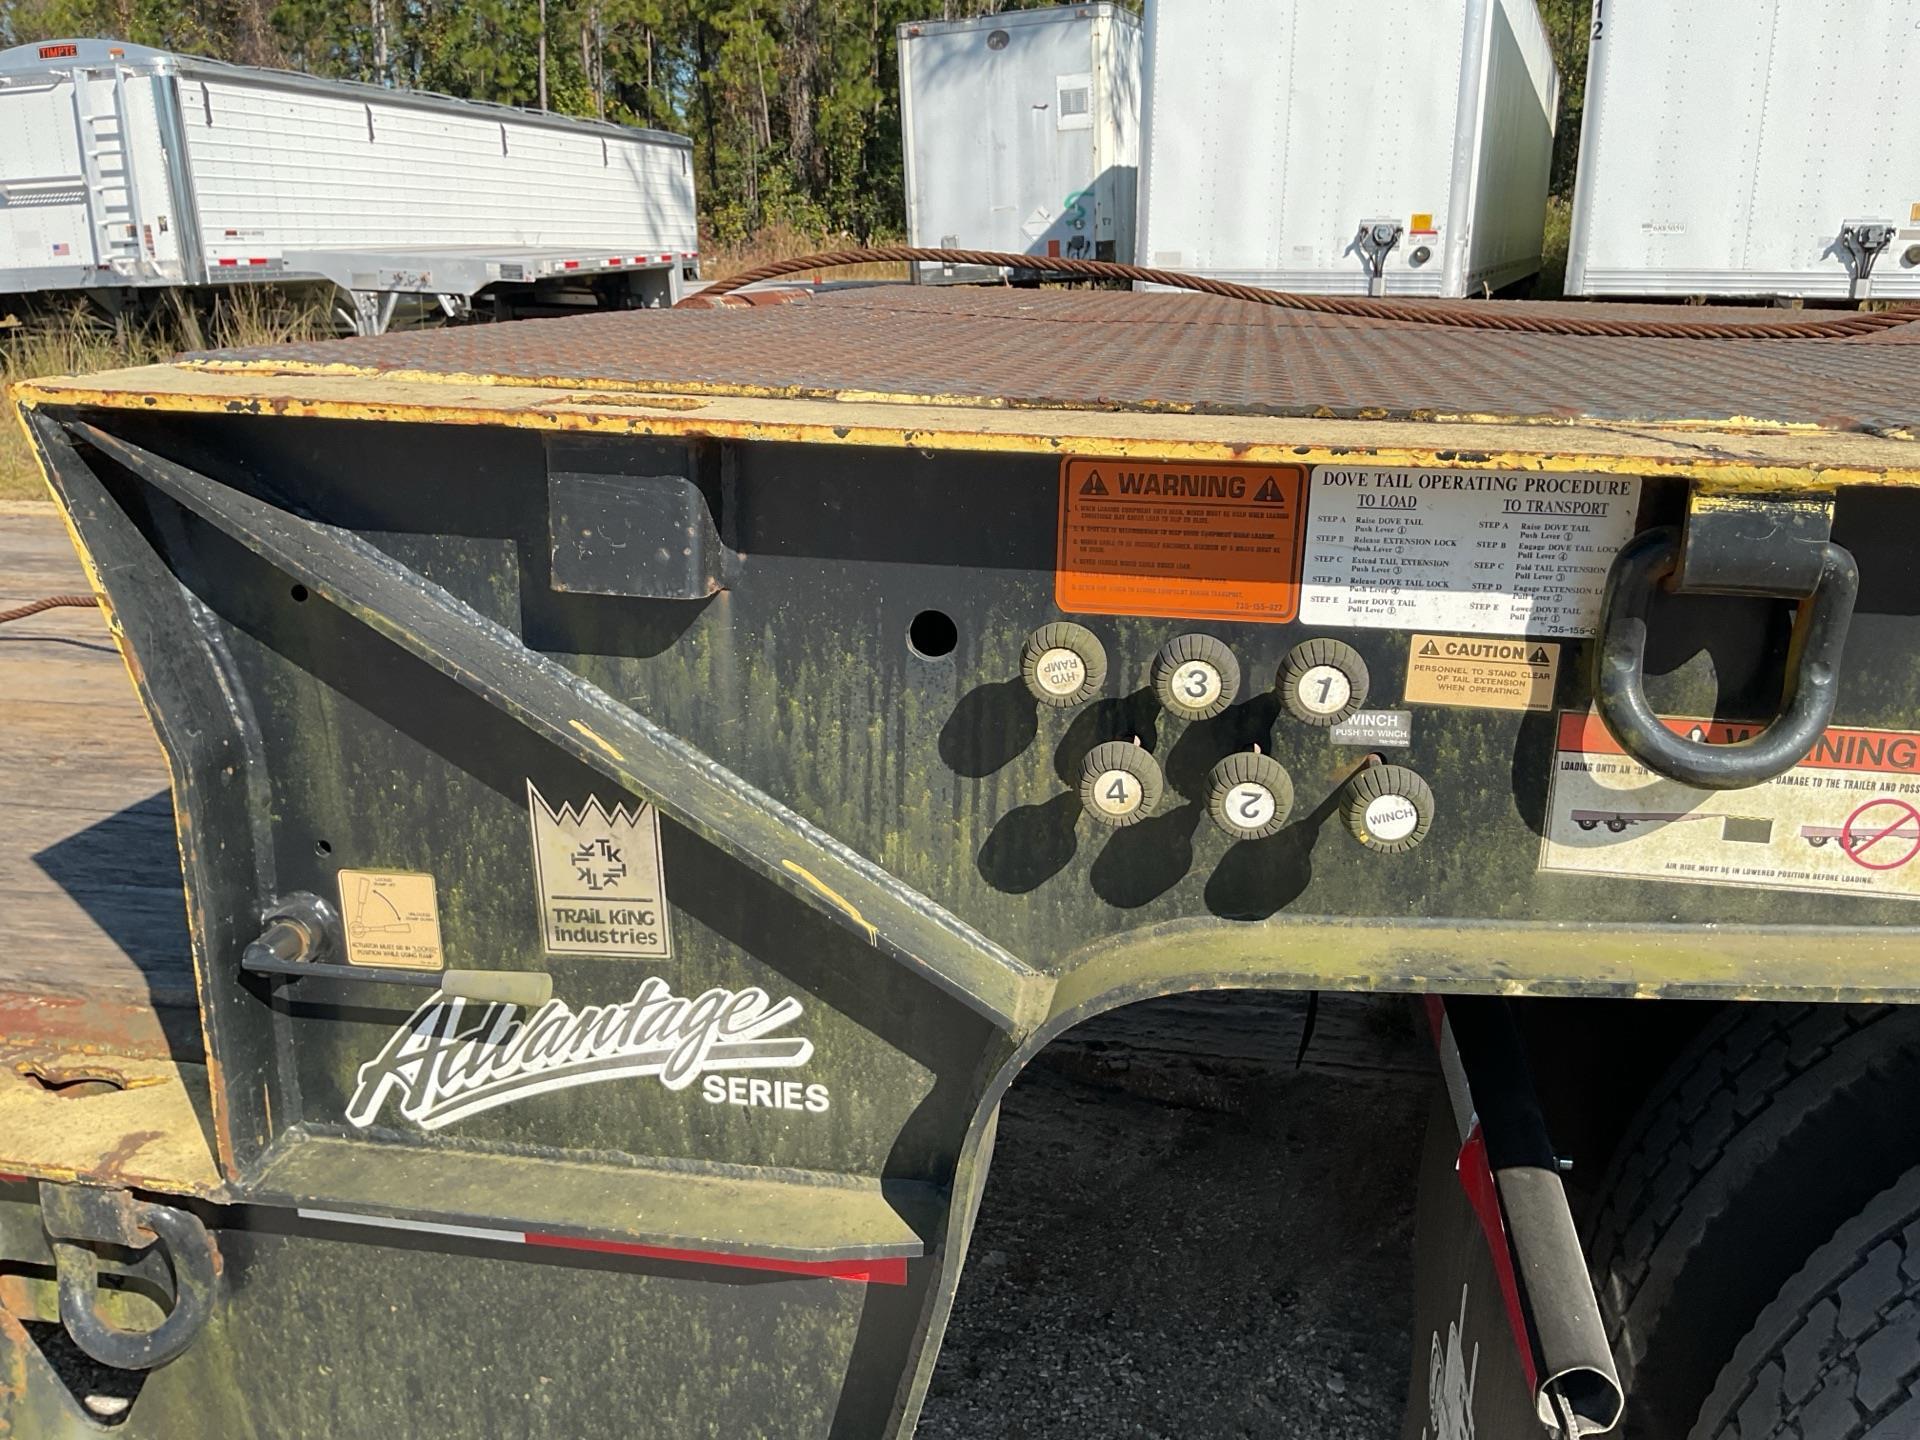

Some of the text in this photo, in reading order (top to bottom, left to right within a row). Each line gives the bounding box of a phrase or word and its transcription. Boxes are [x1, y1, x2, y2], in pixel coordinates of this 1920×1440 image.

[41, 45, 76, 58] TIMPTE
[1119, 473, 1246, 498] WARNING
[1323, 472, 1631, 495] DOVE TAIL OPERATING PROCEDURE
[1358, 494, 1417, 508] TO LOAD
[1504, 499, 1609, 515] TO TRANSPORT
[1519, 543, 1545, 551] Engage
[1401, 559, 1449, 567] EXTENSION
[1543, 586, 1591, 594] EXTENSION
[1446, 643, 1524, 659] CAUTION
[1044, 658, 1077, 673] RAMP
[1414, 665, 1467, 674] PERSONNEL
[1488, 670, 1516, 678] STAND
[1521, 671, 1550, 680] CLEAR
[1051, 672, 1076, 685] HYD
[1185, 669, 1208, 698] 3
[1437, 674, 1449, 682] OF
[1474, 678, 1526, 687] EXTENSION
[1317, 677, 1333, 704] 1
[1469, 686, 1522, 695] OPERATING.
[1348, 714, 1398, 726] WINCH
[1377, 730, 1407, 738] WINCH
[1561, 761, 1592, 772] LOADING
[1596, 763, 1616, 773] ONTO
[1619, 765, 1630, 774] AN
[1106, 778, 1128, 803] 4
[1776, 776, 1808, 787] DAMAGE
[1812, 777, 1822, 787] TO
[1826, 778, 1840, 788] THE
[1844, 780, 1876, 790] TRAILER
[1879, 782, 1896, 792] AND
[1239, 791, 1262, 819] 2
[1370, 808, 1414, 825] WINCH
[1742, 869, 1775, 877] LOWERED
[1778, 871, 1810, 879] POSITION
[1813, 873, 1838, 881] BEFORE
[1842, 875, 1874, 884] LOADING.
[555, 926, 658, 945] industries
[345, 976, 812, 1128] Advantage
[702, 1075, 830, 1112] SERIES
